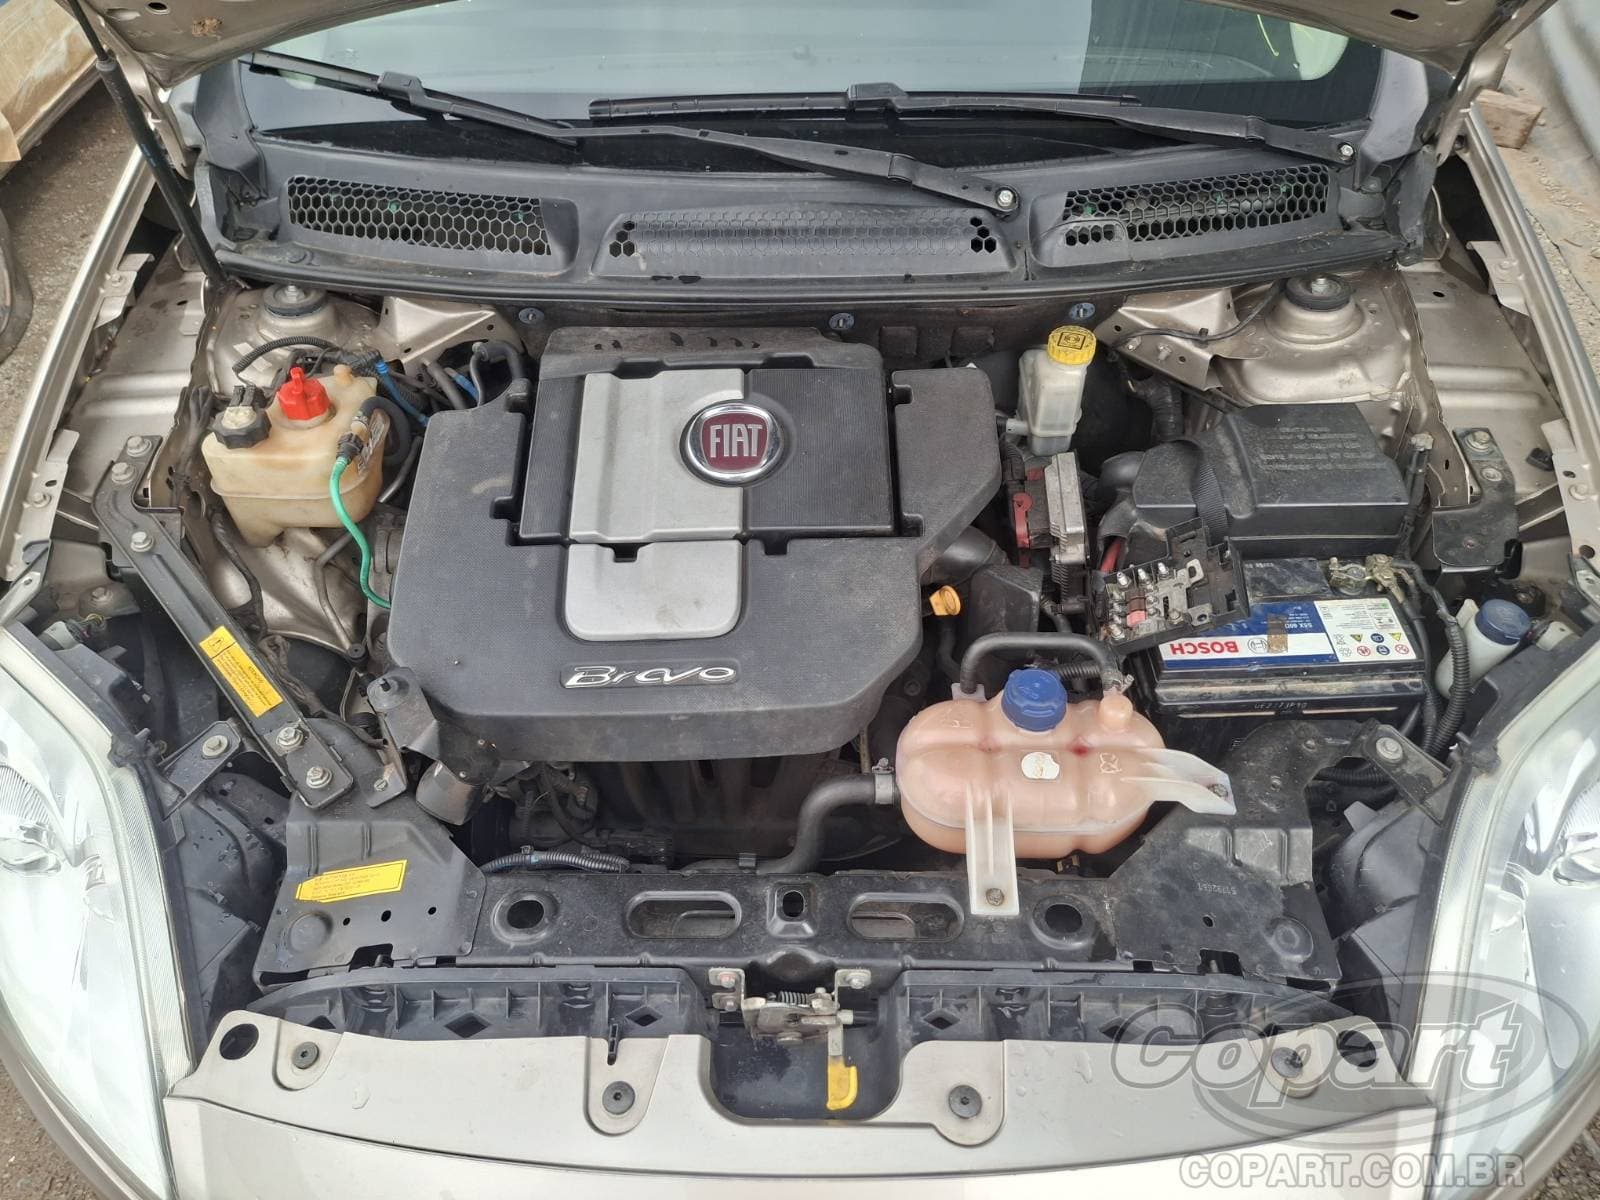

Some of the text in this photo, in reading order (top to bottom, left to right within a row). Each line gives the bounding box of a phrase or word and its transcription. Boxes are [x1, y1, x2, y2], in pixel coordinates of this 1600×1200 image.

[710, 423, 762, 458] FIAT
[1170, 640, 1240, 656] BOSCH
[563, 665, 737, 689] Bravo
